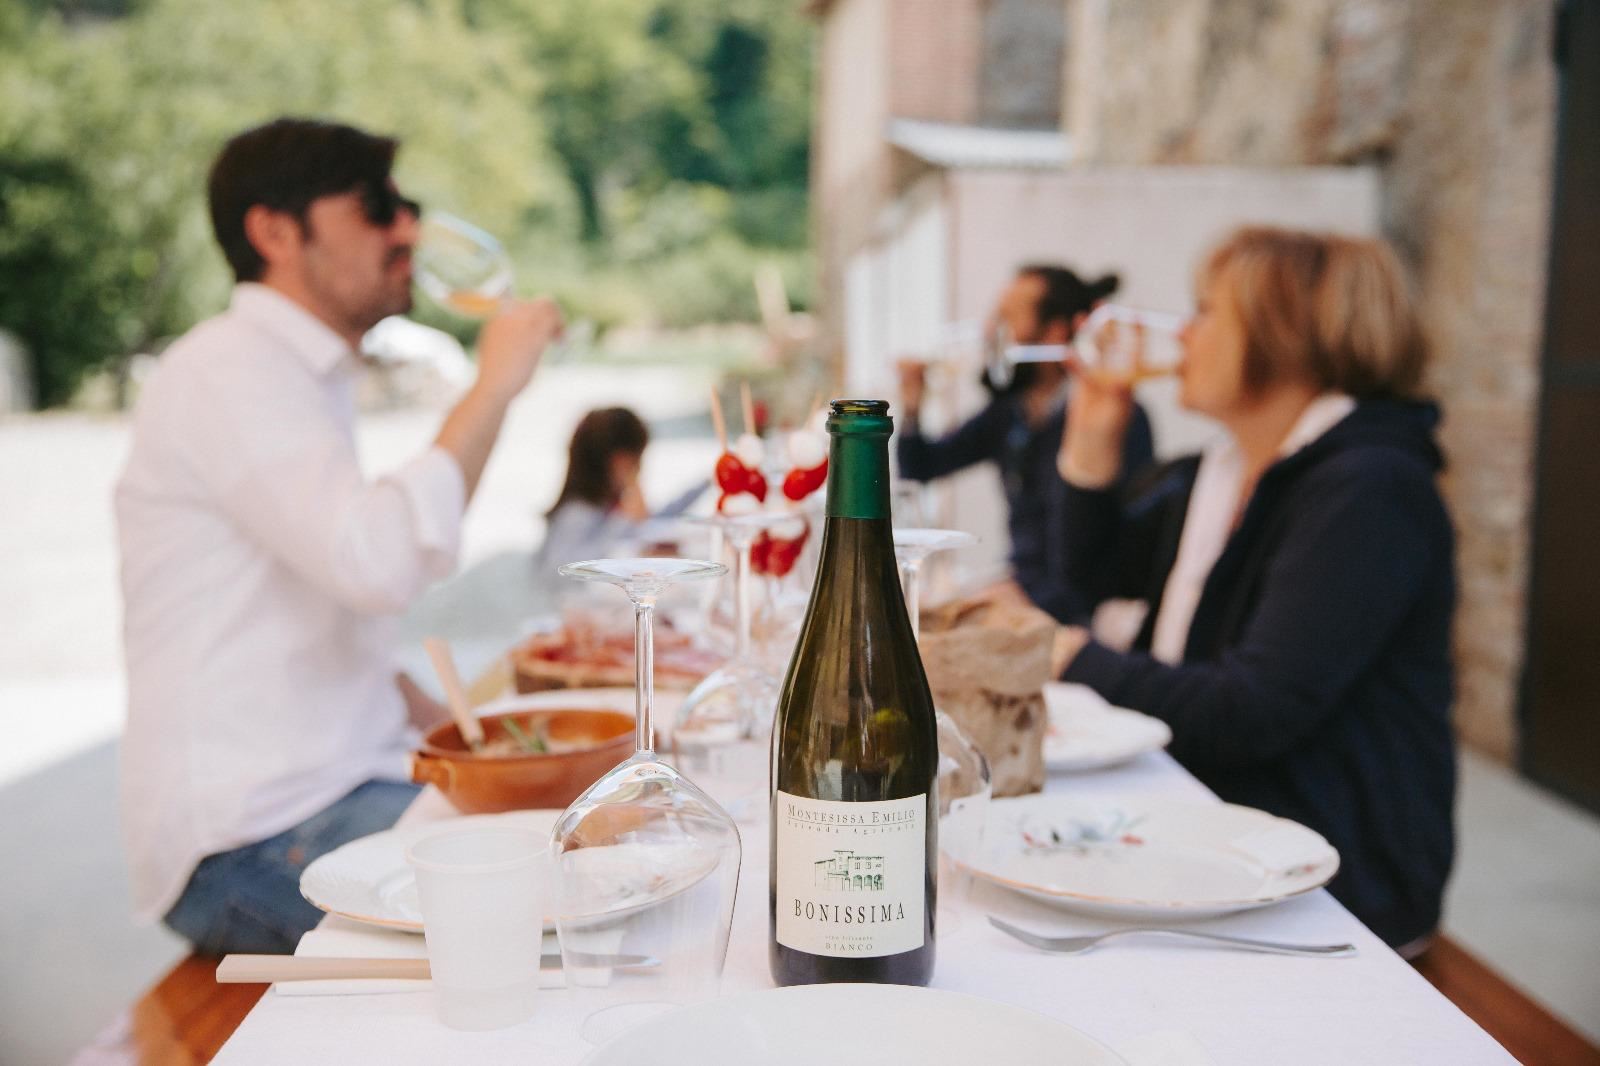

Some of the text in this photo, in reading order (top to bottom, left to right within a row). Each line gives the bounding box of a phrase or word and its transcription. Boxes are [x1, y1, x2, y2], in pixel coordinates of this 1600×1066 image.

[788, 804, 915, 824] MONTESISSA EMILIO
[795, 899, 905, 924] BONISSIMA
[825, 943, 873, 951] BIANCO
